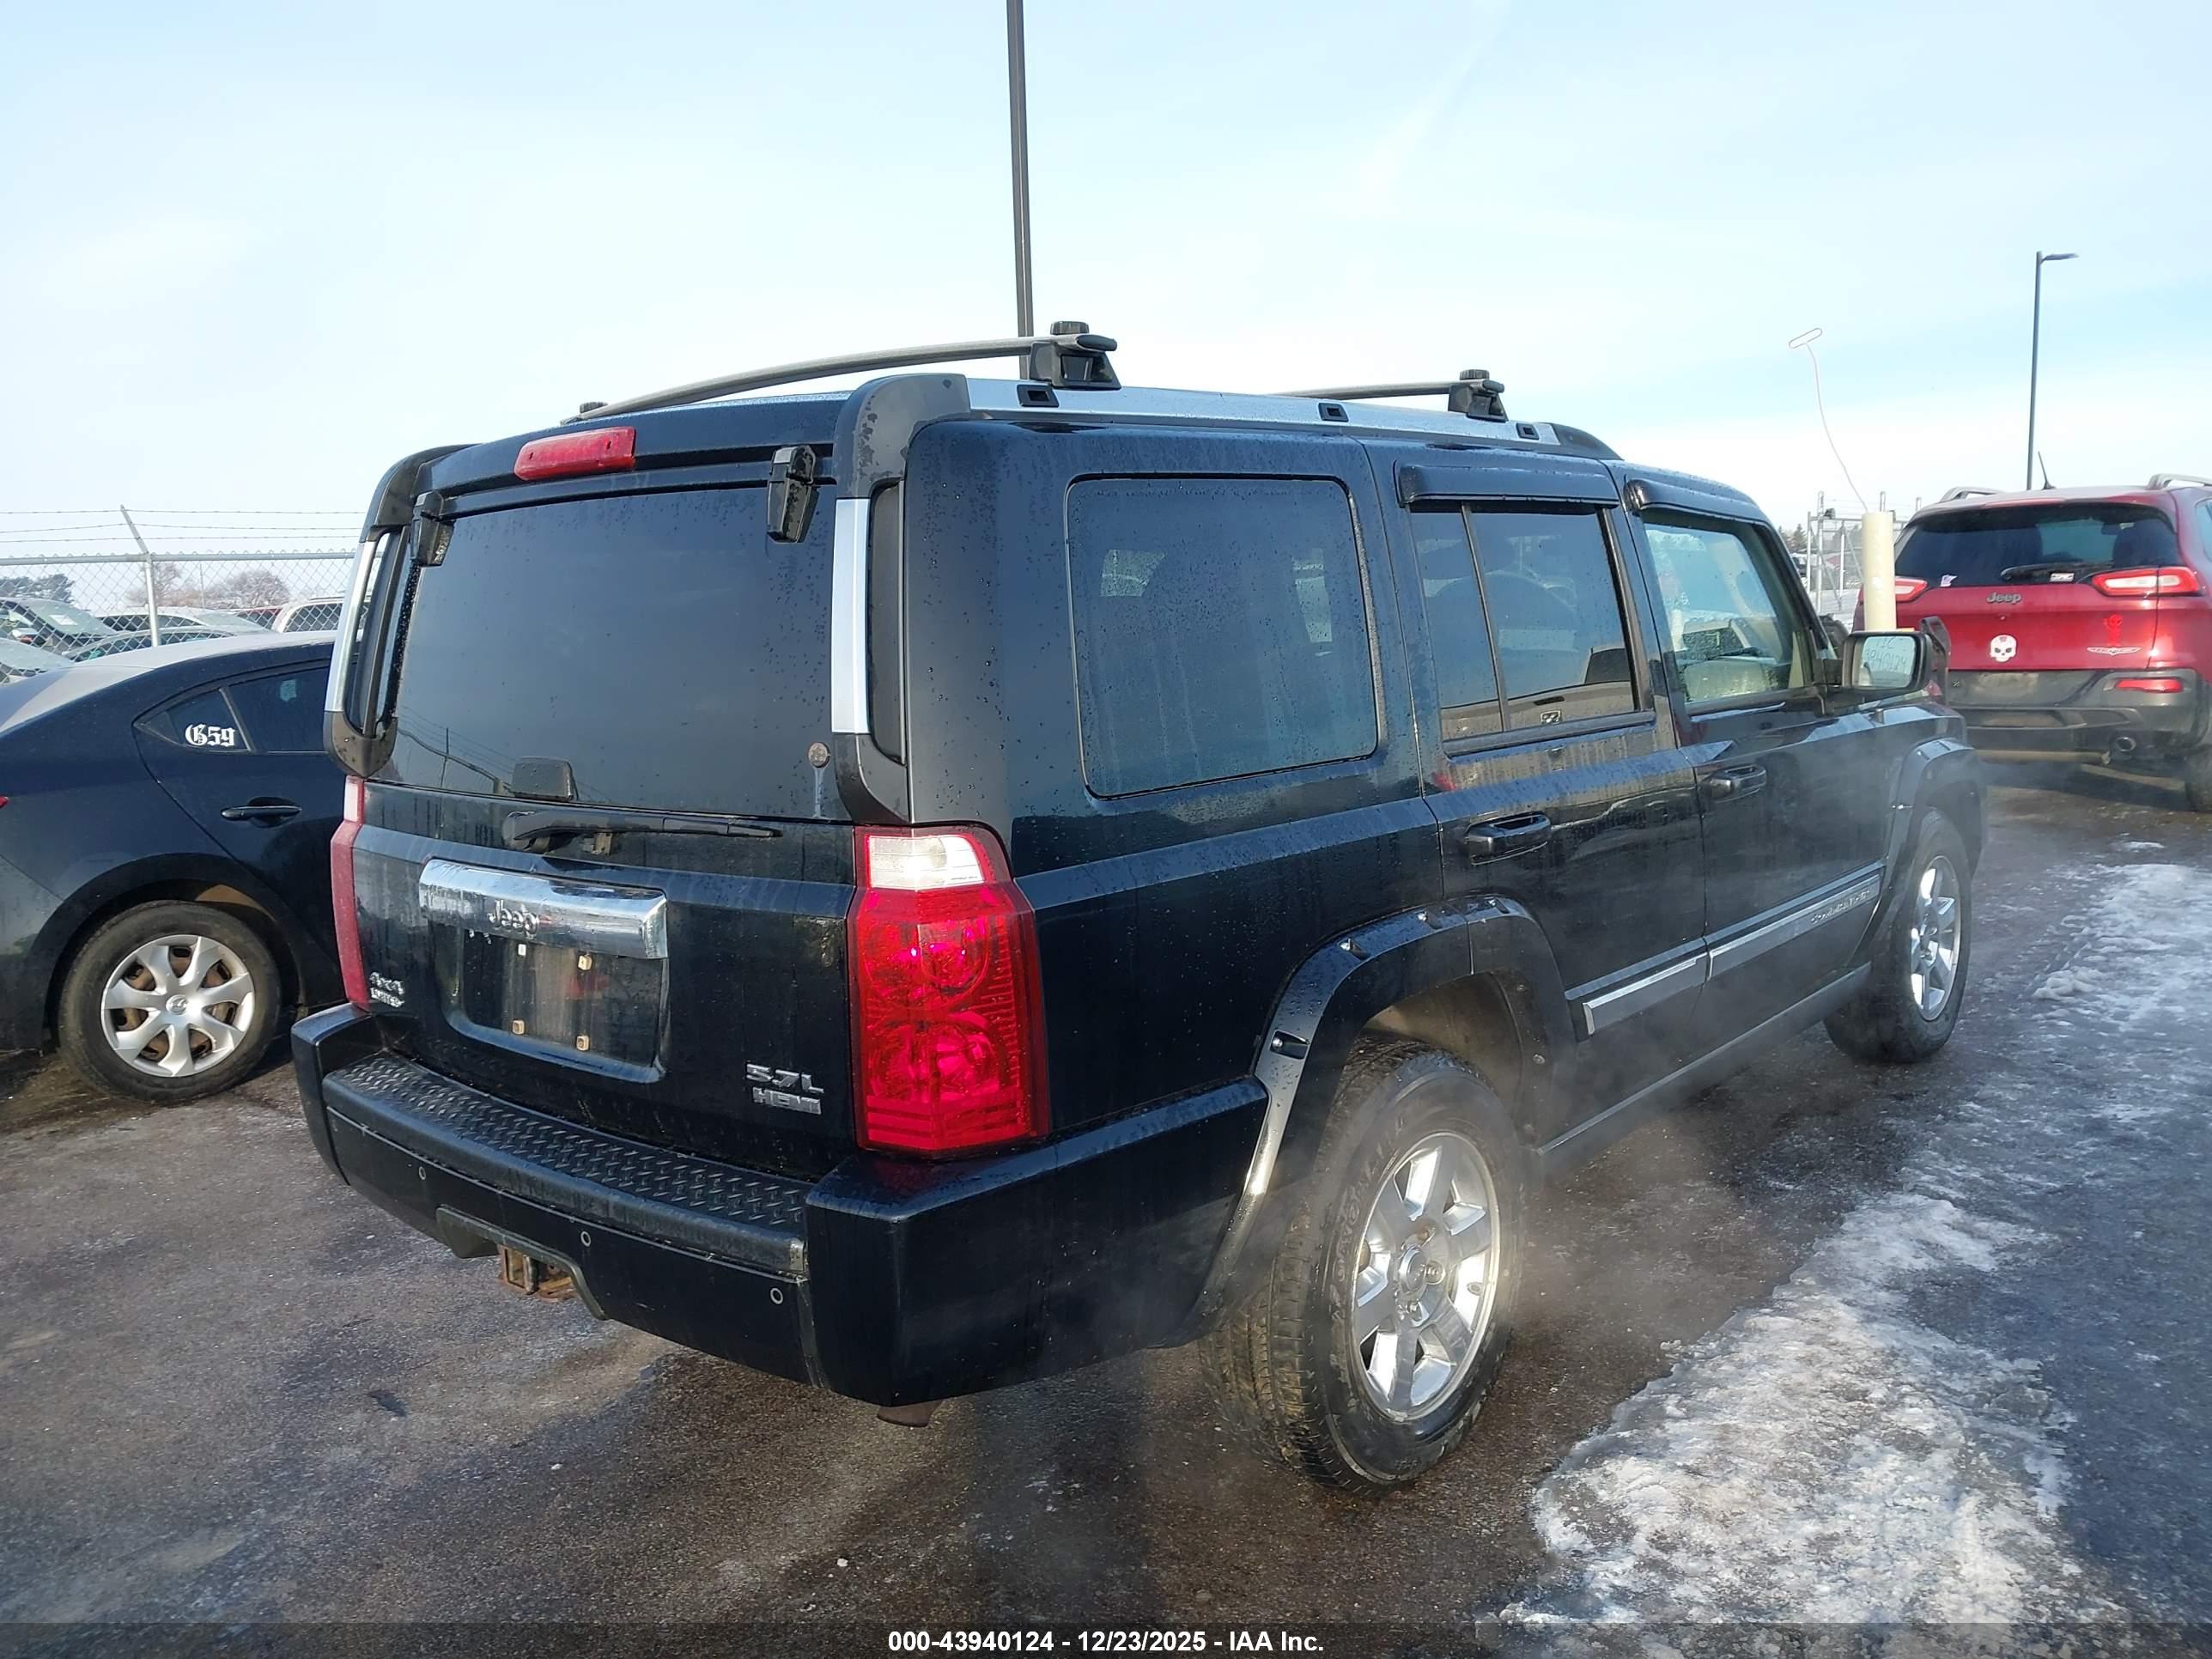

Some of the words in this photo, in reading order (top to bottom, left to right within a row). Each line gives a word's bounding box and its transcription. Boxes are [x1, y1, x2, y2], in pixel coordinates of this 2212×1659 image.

[1985, 591, 2022, 605] Jeep
[185, 723, 235, 747] G59
[487, 899, 539, 939] Jeep
[745, 1063, 824, 1094] 5.7L
[752, 1086, 822, 1115] HEMI
